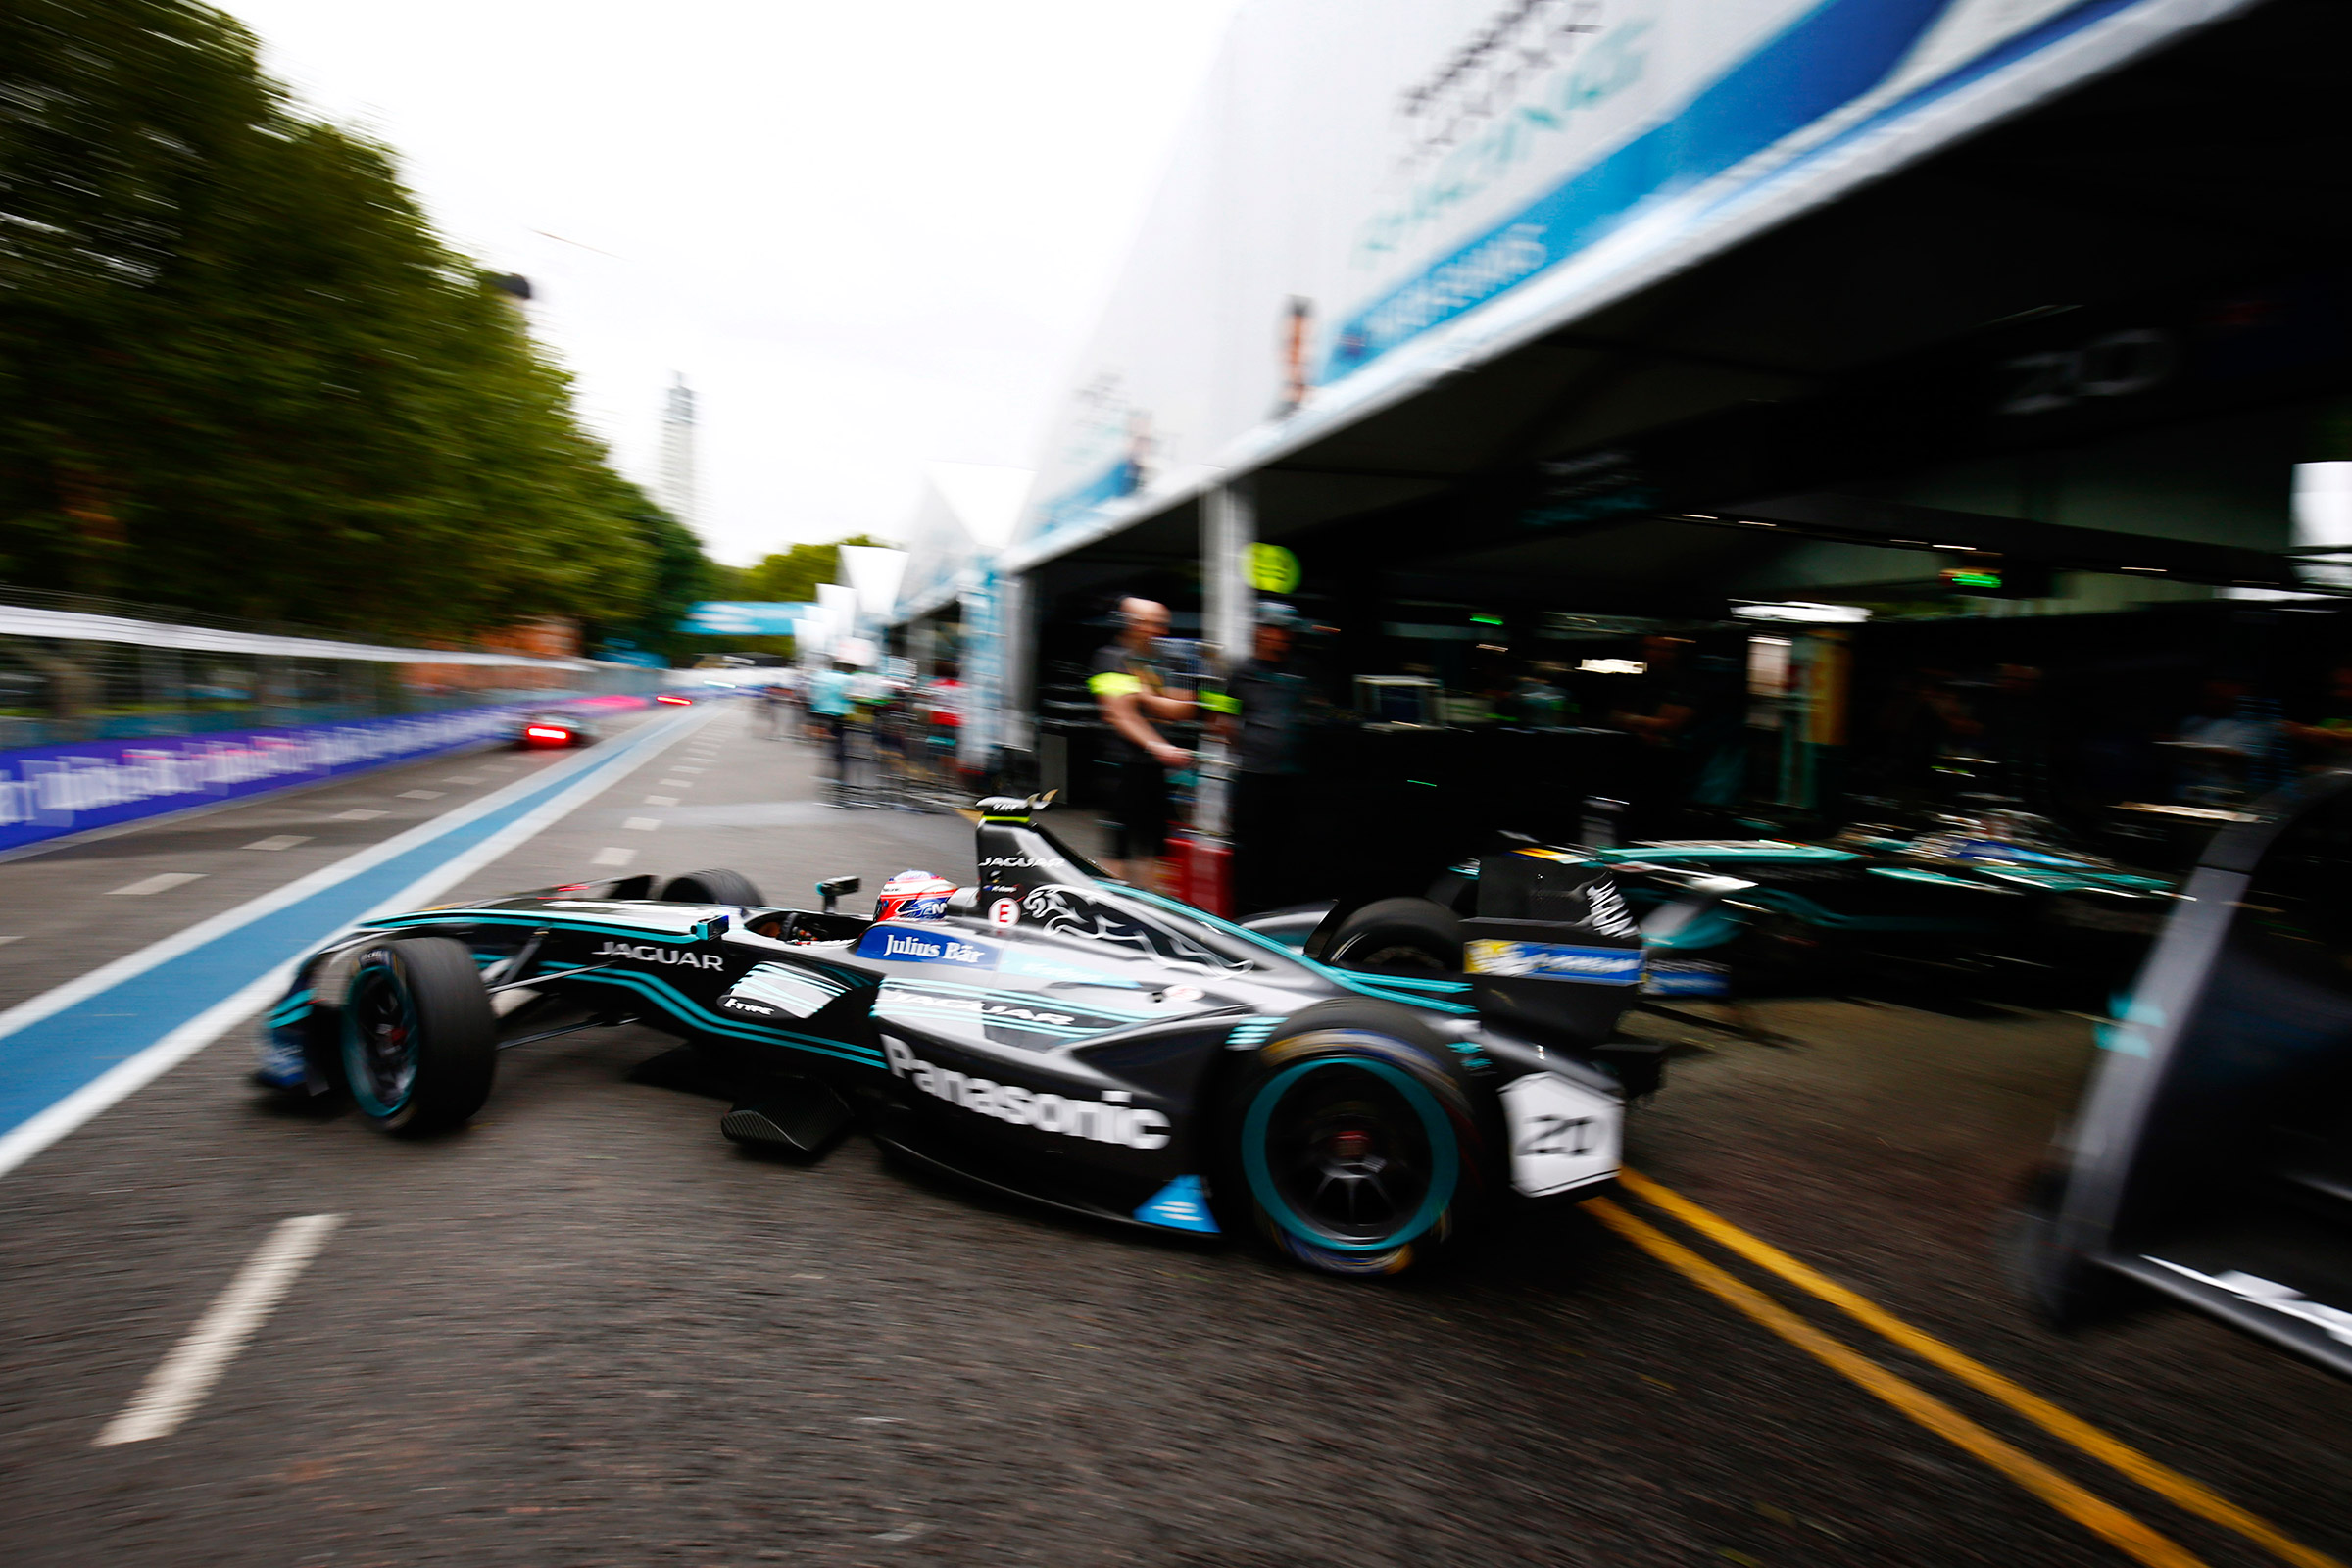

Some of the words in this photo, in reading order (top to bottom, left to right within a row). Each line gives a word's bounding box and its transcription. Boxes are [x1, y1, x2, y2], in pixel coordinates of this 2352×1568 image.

[999, 904, 1011, 923] E
[591, 941, 724, 971] JAGUAR
[883, 934, 941, 957] Julius
[942, 942, 986, 963] Bär
[875, 989, 1074, 1026] JAGUAR
[881, 1034, 1172, 1150] Panasonic
